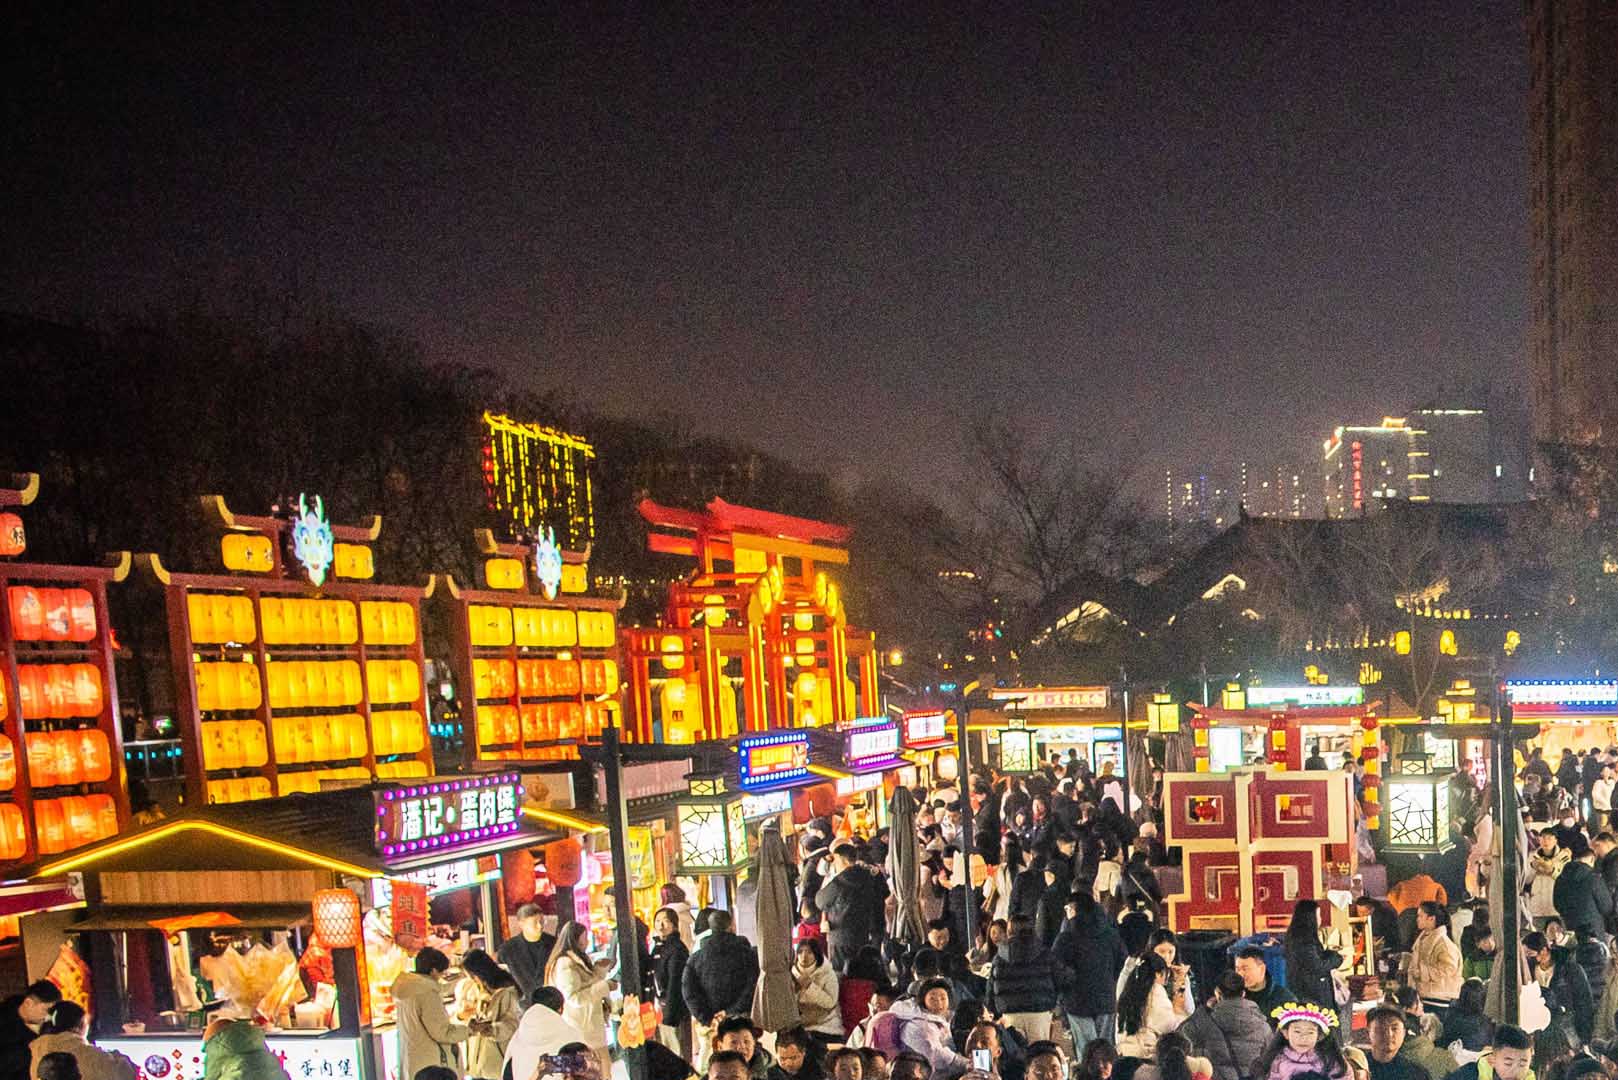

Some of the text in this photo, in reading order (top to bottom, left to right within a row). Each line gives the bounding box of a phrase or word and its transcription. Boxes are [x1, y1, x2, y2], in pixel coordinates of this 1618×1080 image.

[401, 785, 516, 841] 潘记·蛋肉堡
